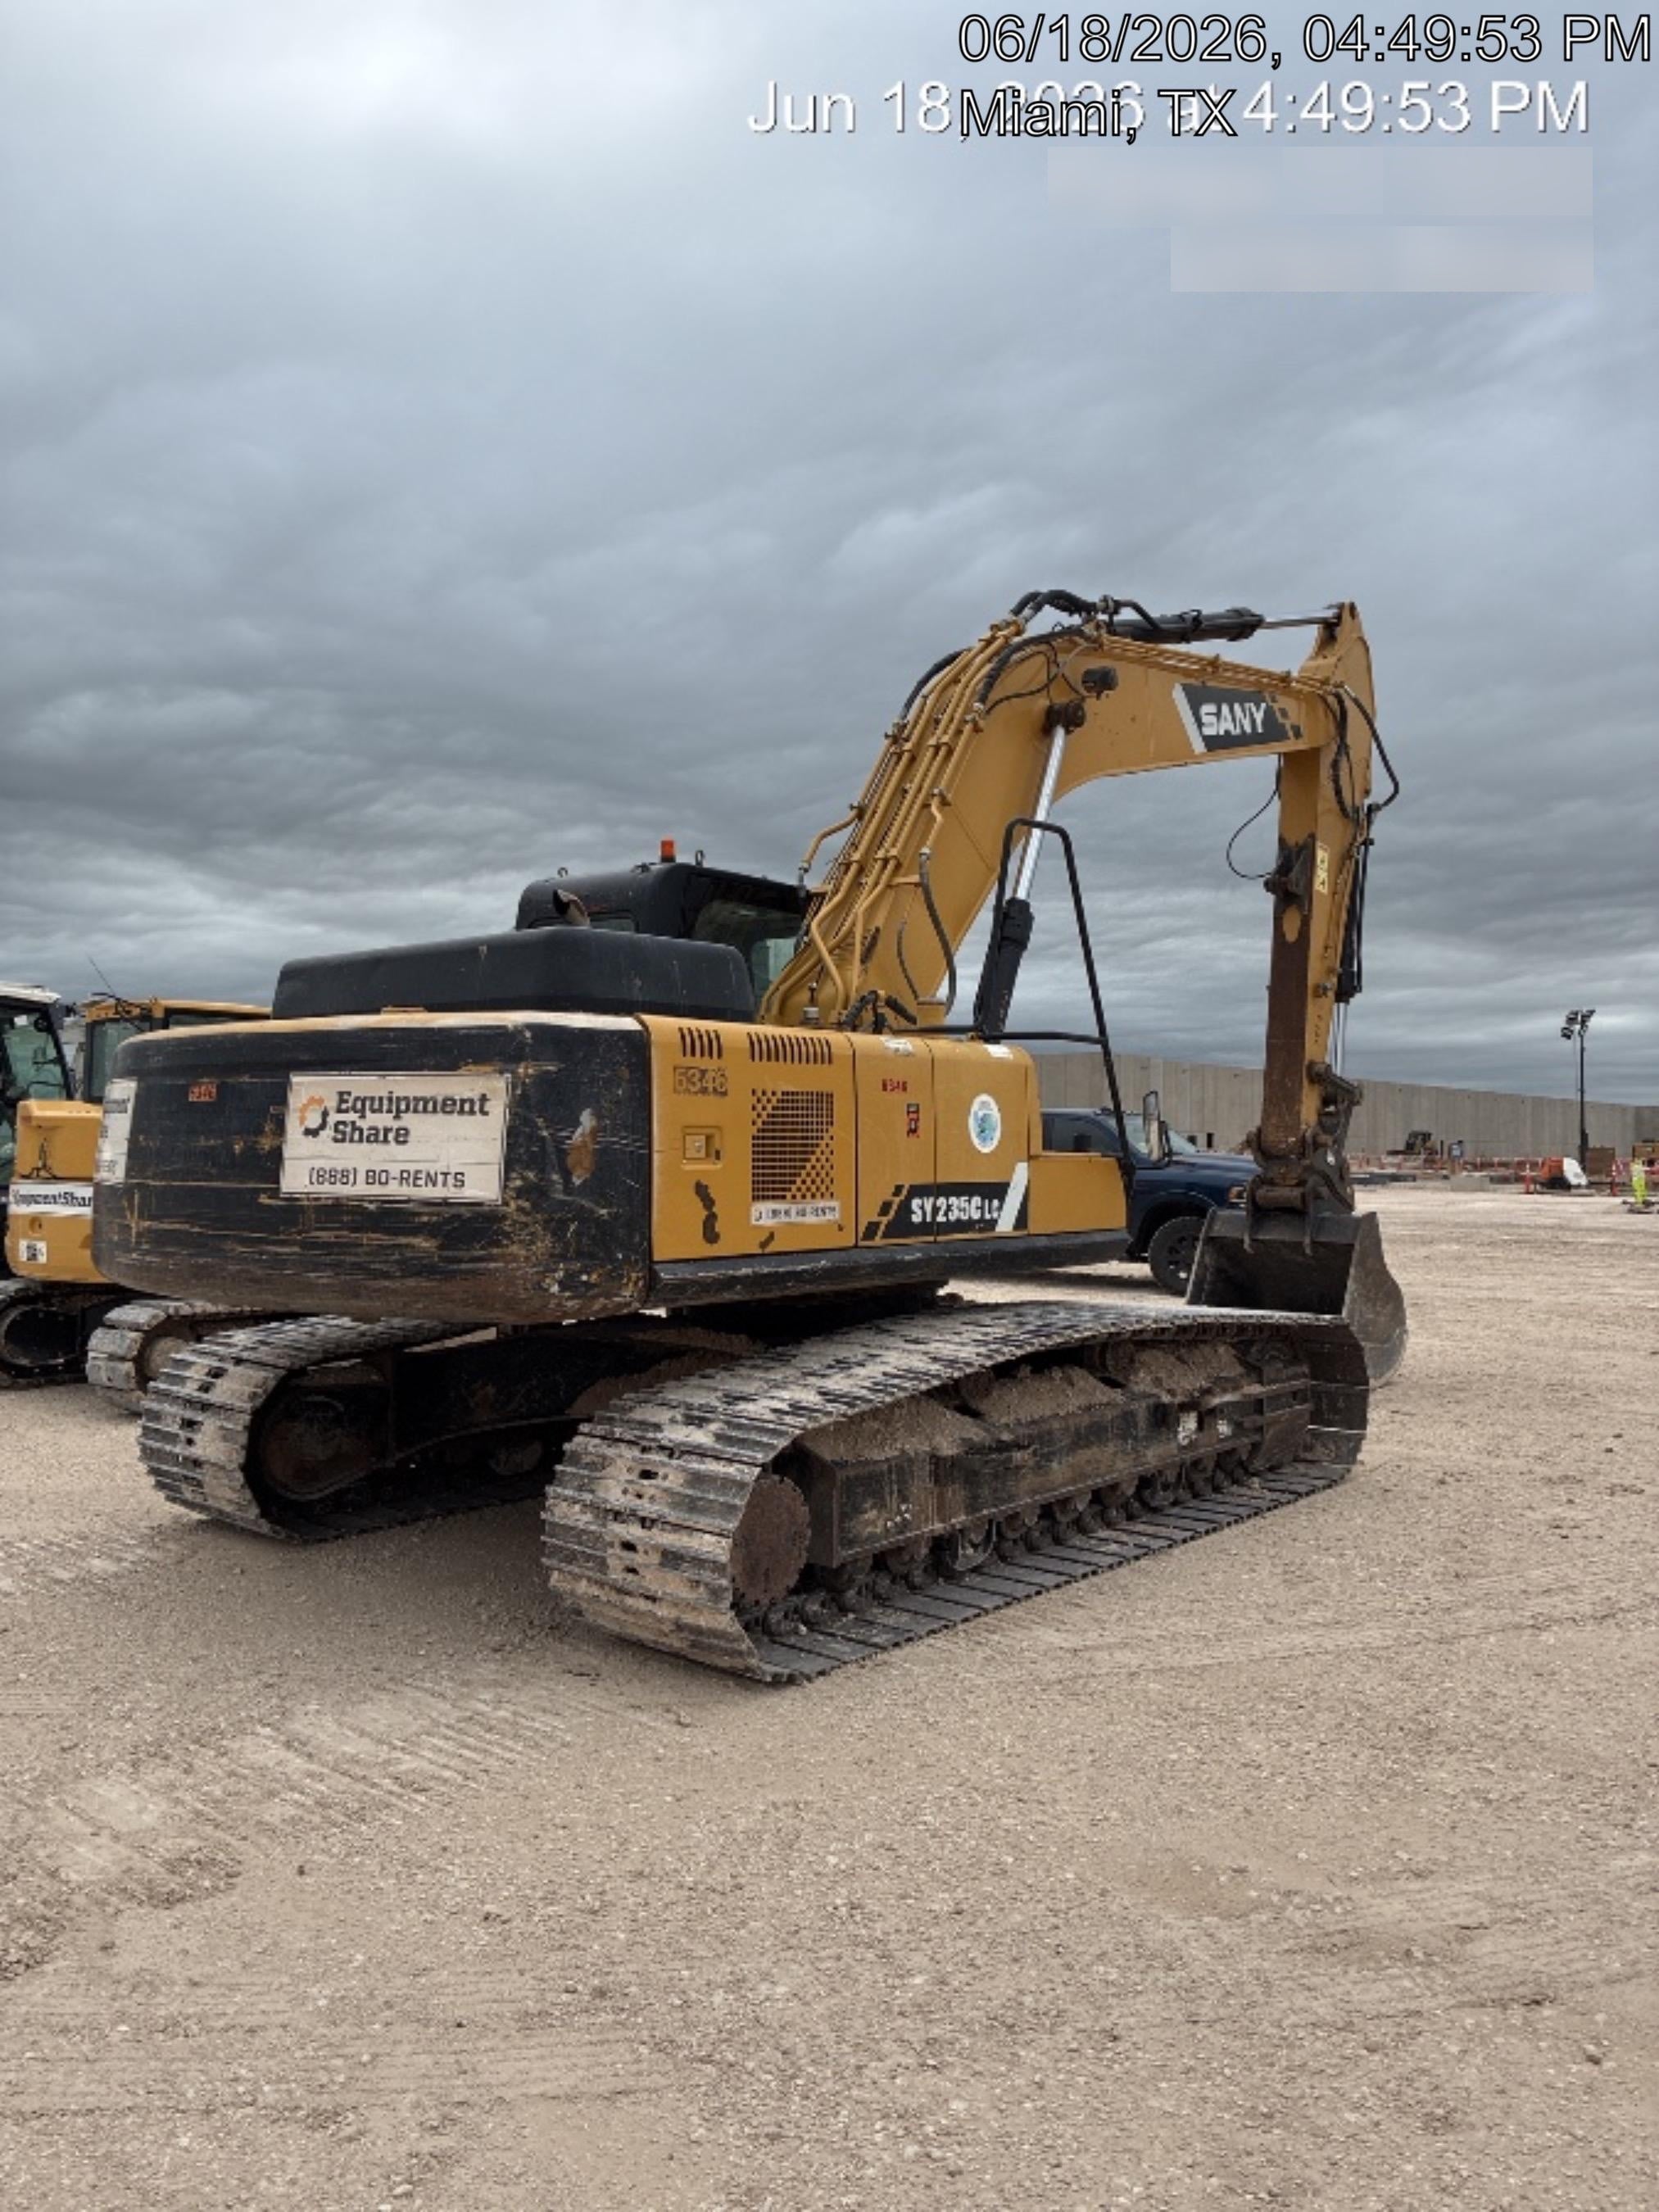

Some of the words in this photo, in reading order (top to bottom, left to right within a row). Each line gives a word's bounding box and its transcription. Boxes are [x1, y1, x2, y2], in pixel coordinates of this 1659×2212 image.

[1198, 701, 1267, 736] SANY
[334, 1090, 491, 1120] Equipment
[331, 1120, 410, 1145] Share
[308, 1166, 358, 1188] (888)
